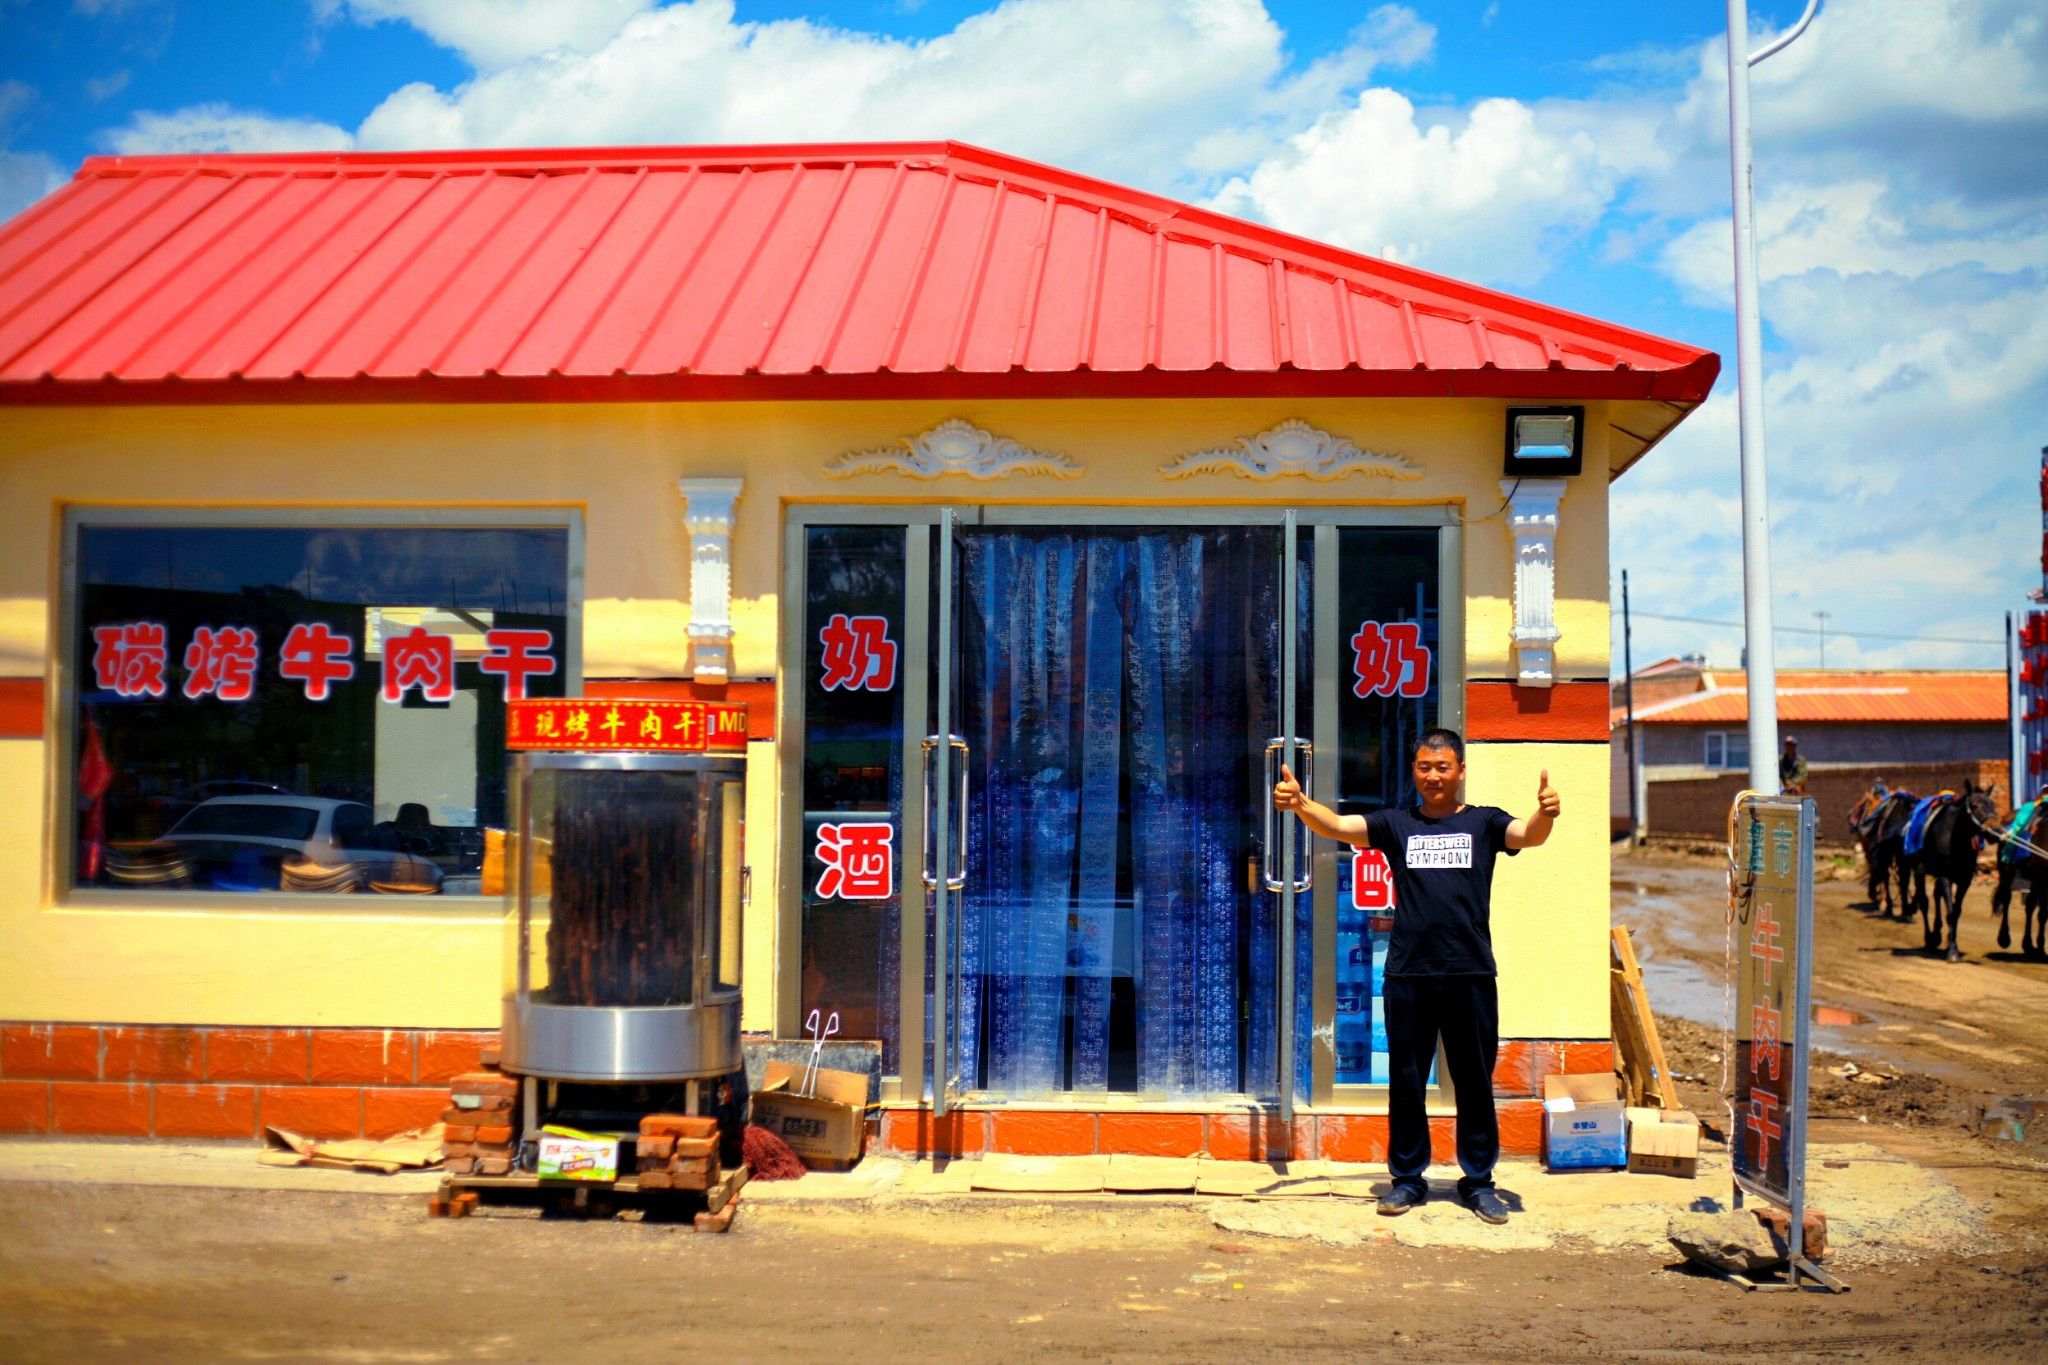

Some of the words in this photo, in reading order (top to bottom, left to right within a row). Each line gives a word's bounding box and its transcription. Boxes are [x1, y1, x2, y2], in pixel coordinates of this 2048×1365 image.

[94, 623, 556, 702] 碳烤牛肉干
[535, 707, 697, 741] 现烤牛肉干
[1408, 852, 1470, 865] SYMPHONY
[1747, 902, 1783, 1170] 牛肉干
